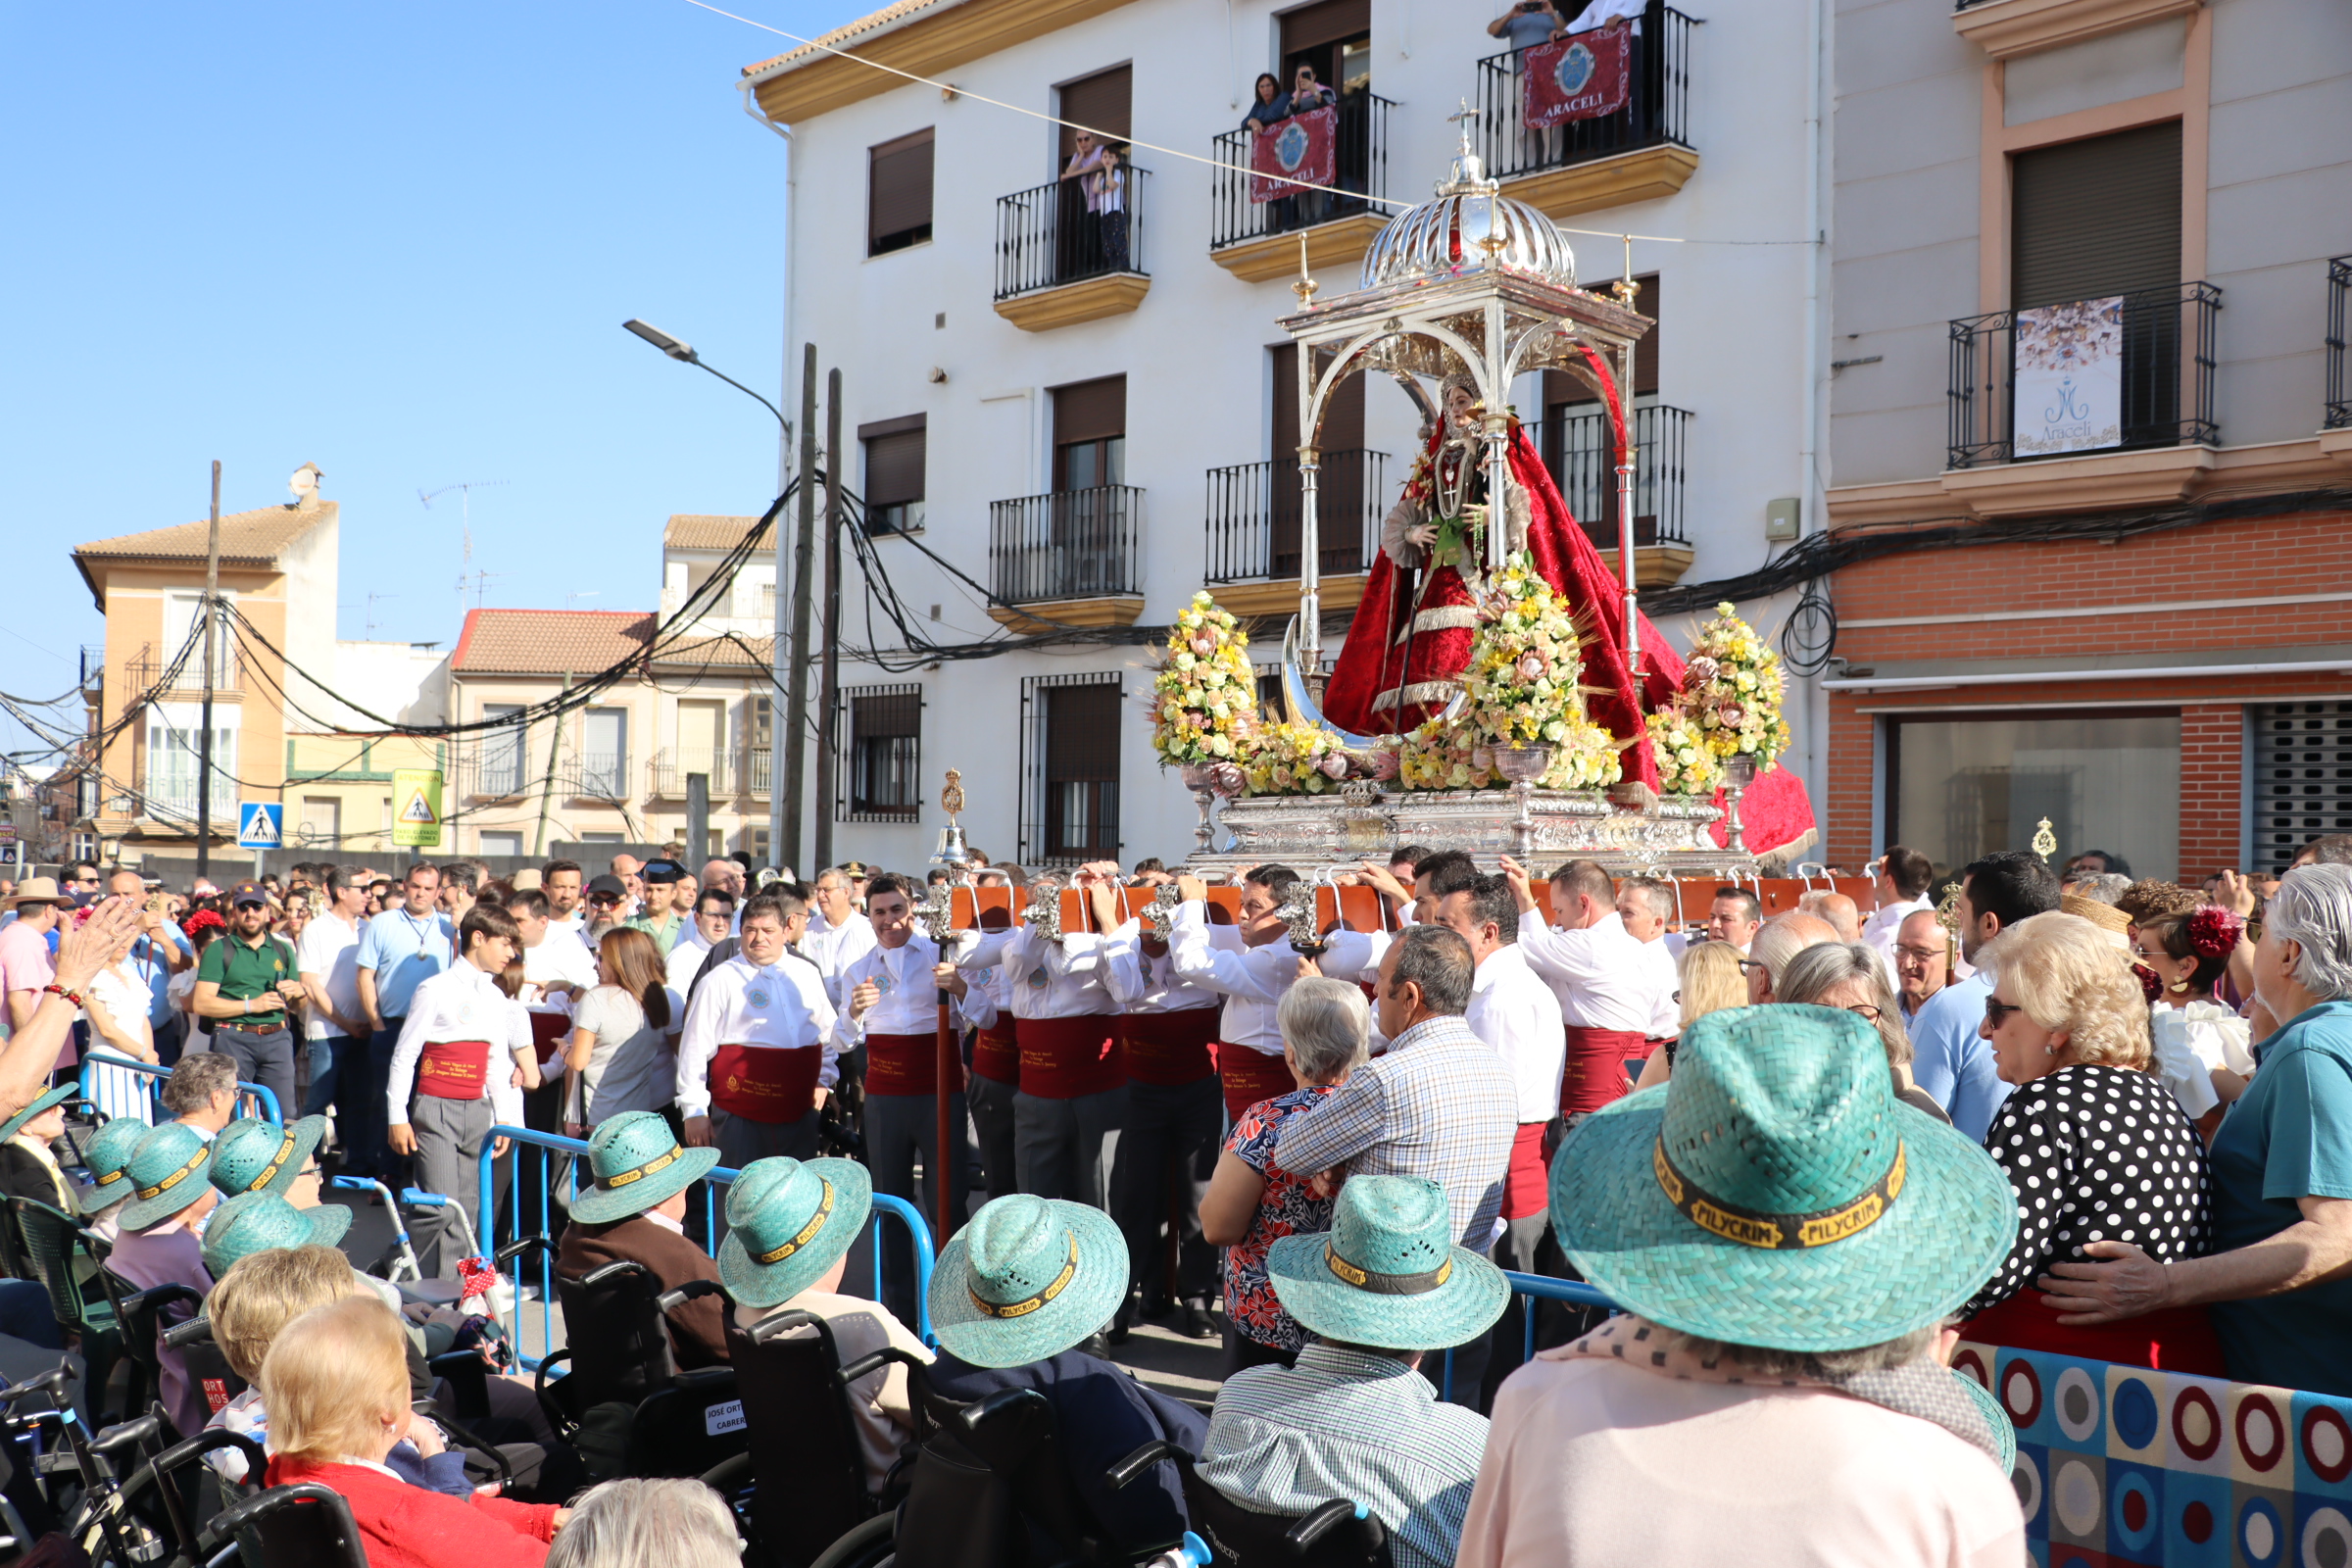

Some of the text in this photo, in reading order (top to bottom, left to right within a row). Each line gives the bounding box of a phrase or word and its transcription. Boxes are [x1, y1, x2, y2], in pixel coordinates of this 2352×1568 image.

[1544, 92, 1602, 118] ARACELI
[1267, 168, 1314, 191] ARACELI
[2041, 421, 2090, 443] Araceli
[800, 1215, 824, 1243] PILYCRIM
[1697, 1206, 1772, 1245] PILYCRIM
[1808, 1200, 1877, 1242] PILYCRIM
[1332, 1256, 1362, 1284] PILYCRIM
[1002, 1299, 1038, 1316] PILYCRIM
[1048, 1267, 1073, 1298] PILYCRIM
[204, 1381, 223, 1391] ORT
[208, 1394, 229, 1403] HOS
[709, 1406, 725, 1419] JOSÉ
